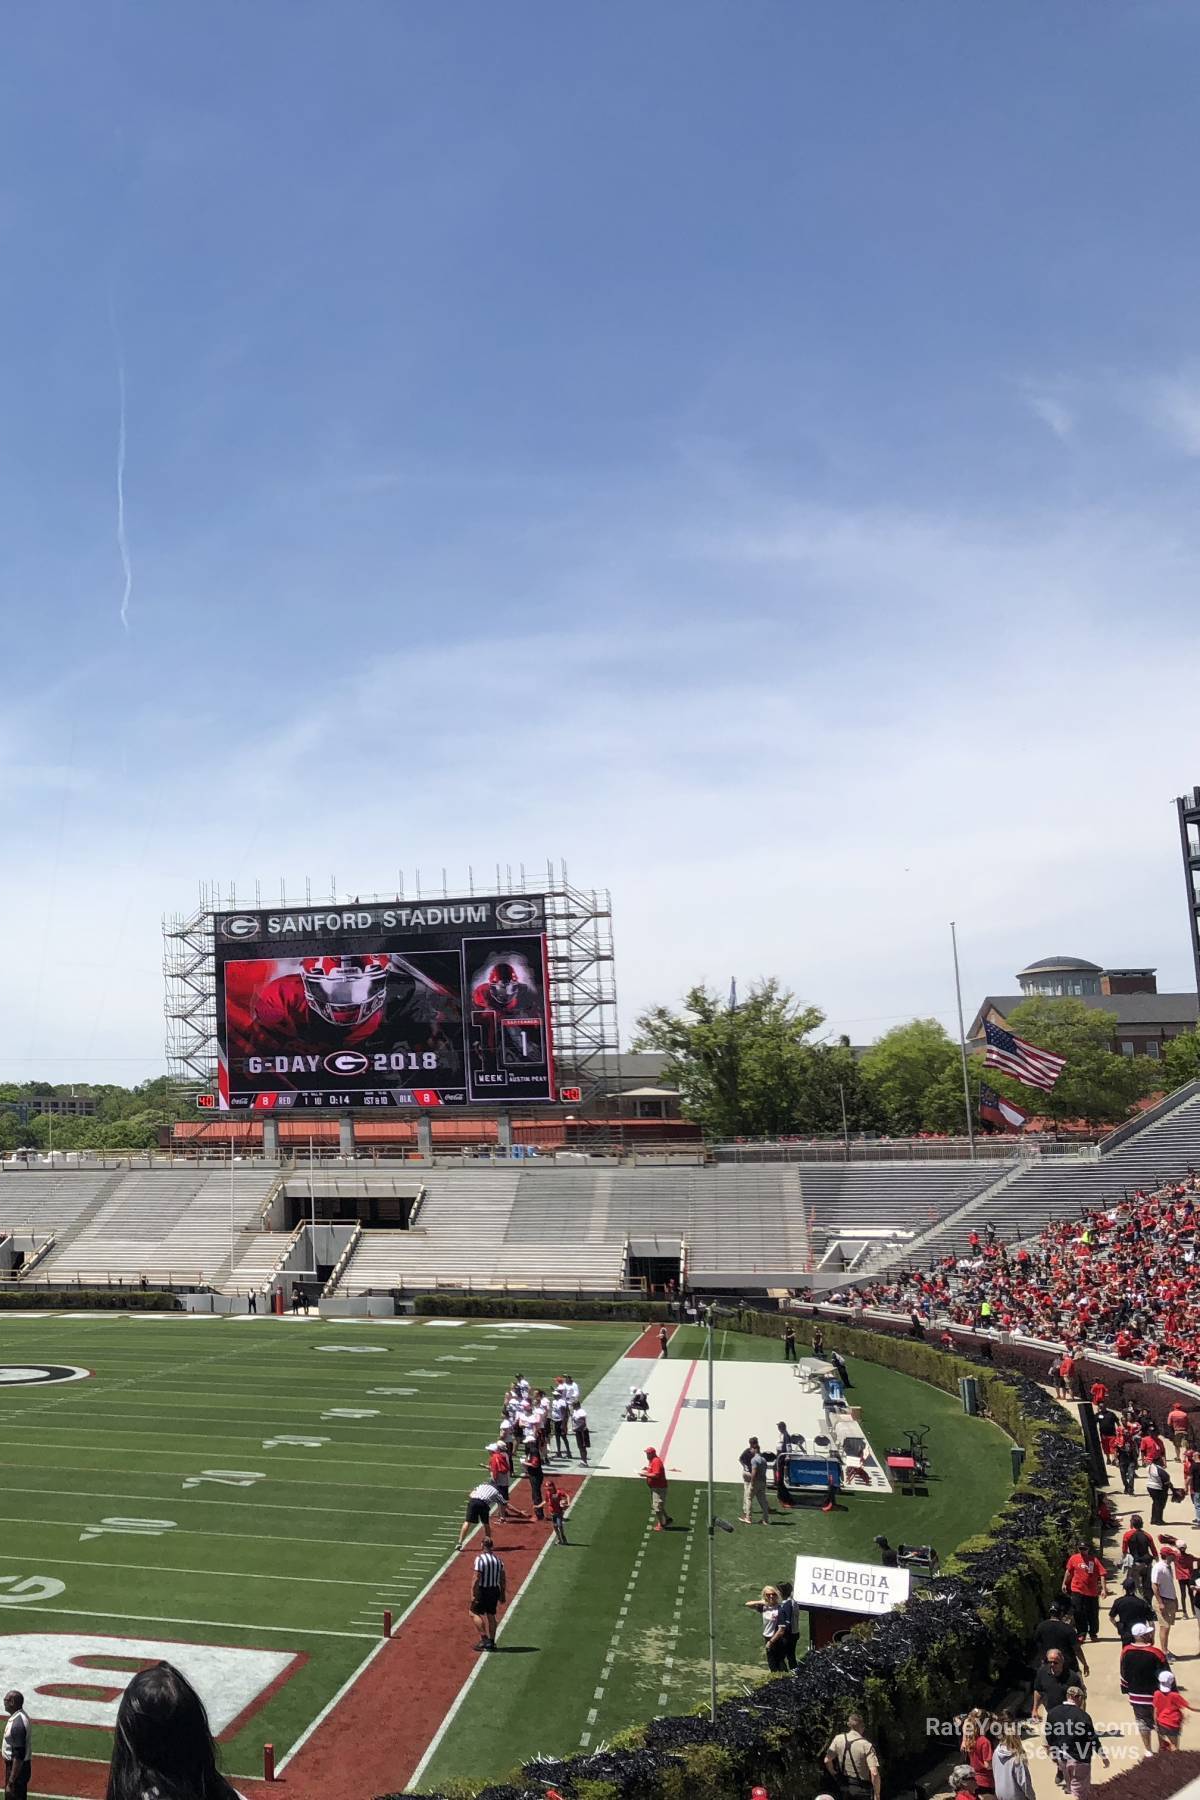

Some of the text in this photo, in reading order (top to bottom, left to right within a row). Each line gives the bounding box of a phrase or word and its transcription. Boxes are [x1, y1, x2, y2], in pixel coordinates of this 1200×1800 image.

[267, 905, 487, 933] SANFORD STADIUM
[249, 1055, 320, 1073] G-DAY
[373, 1052, 437, 1071] 2018
[478, 1074, 503, 1082] WEEK
[329, 1095, 350, 1105] 0:14
[562, 1088, 578, 1100] 40
[199, 1096, 212, 1106] 40
[278, 1096, 291, 1105] RED
[812, 1566, 889, 1588] GEORGIA
[811, 1582, 889, 1605] MASCOT
